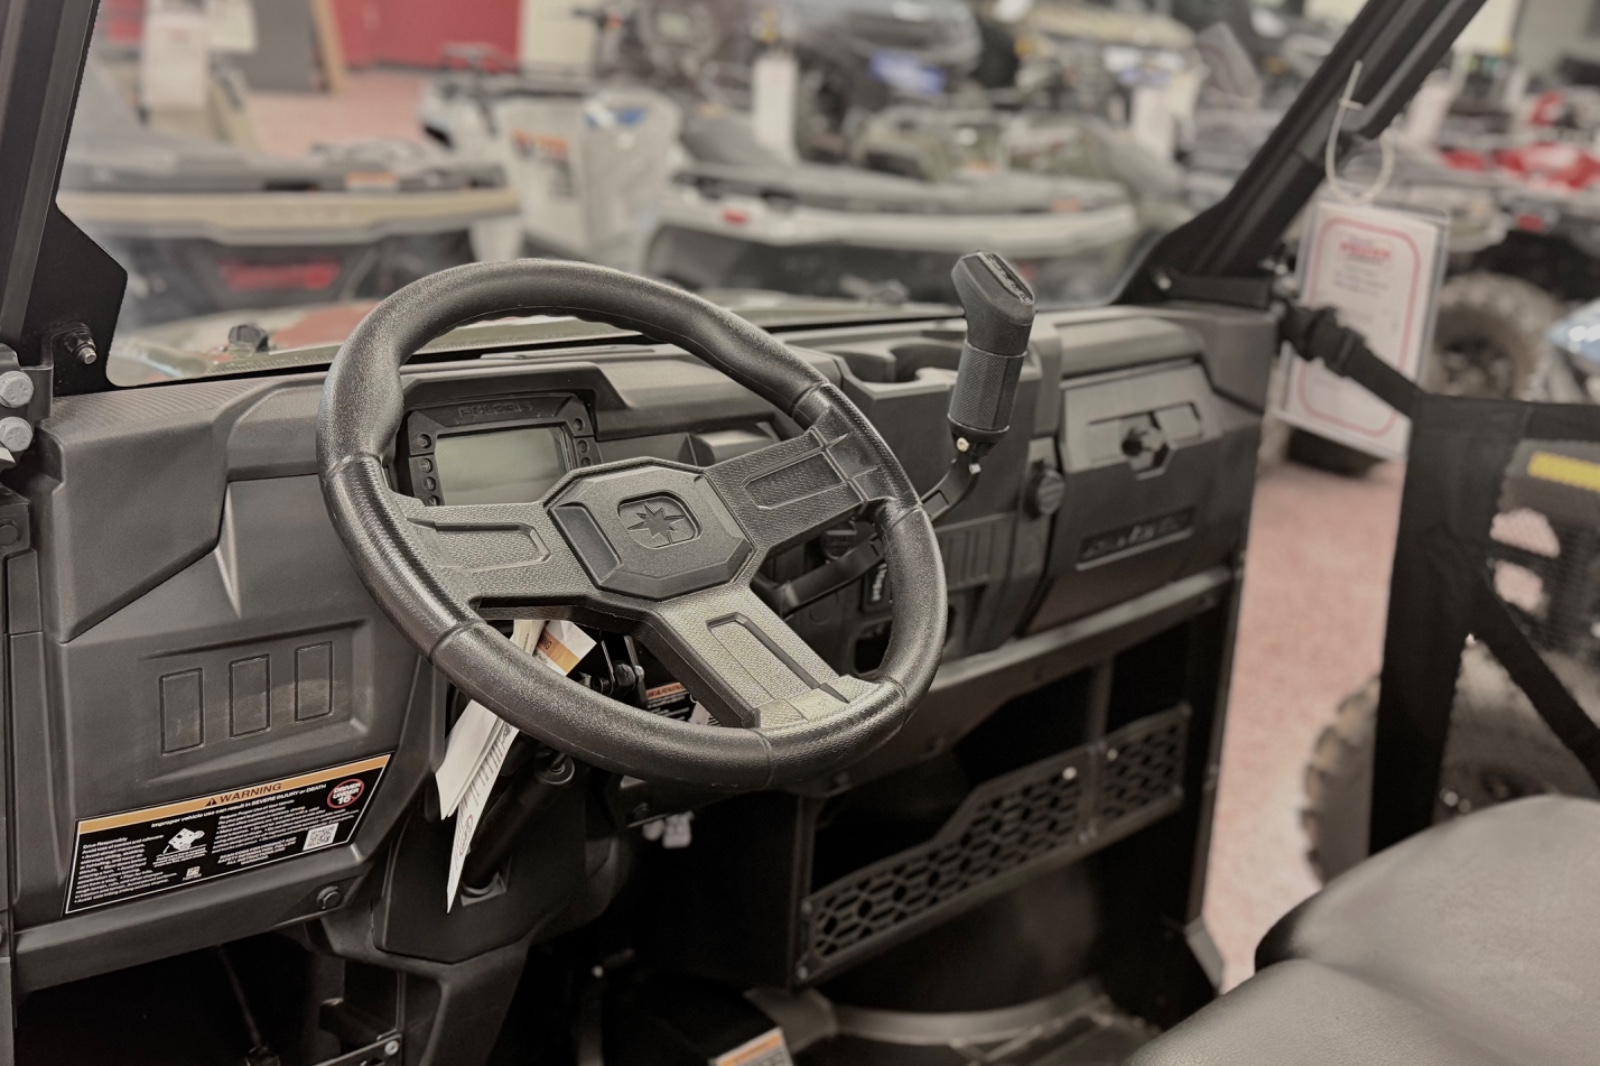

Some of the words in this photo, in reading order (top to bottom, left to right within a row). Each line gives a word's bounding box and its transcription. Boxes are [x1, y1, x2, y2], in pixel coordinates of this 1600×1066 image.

[220, 783, 282, 804] WARNING
[252, 795, 276, 806] SEVERE
[276, 790, 300, 801] INJURY
[306, 784, 327, 793] DEATH
[337, 795, 353, 805] 16
